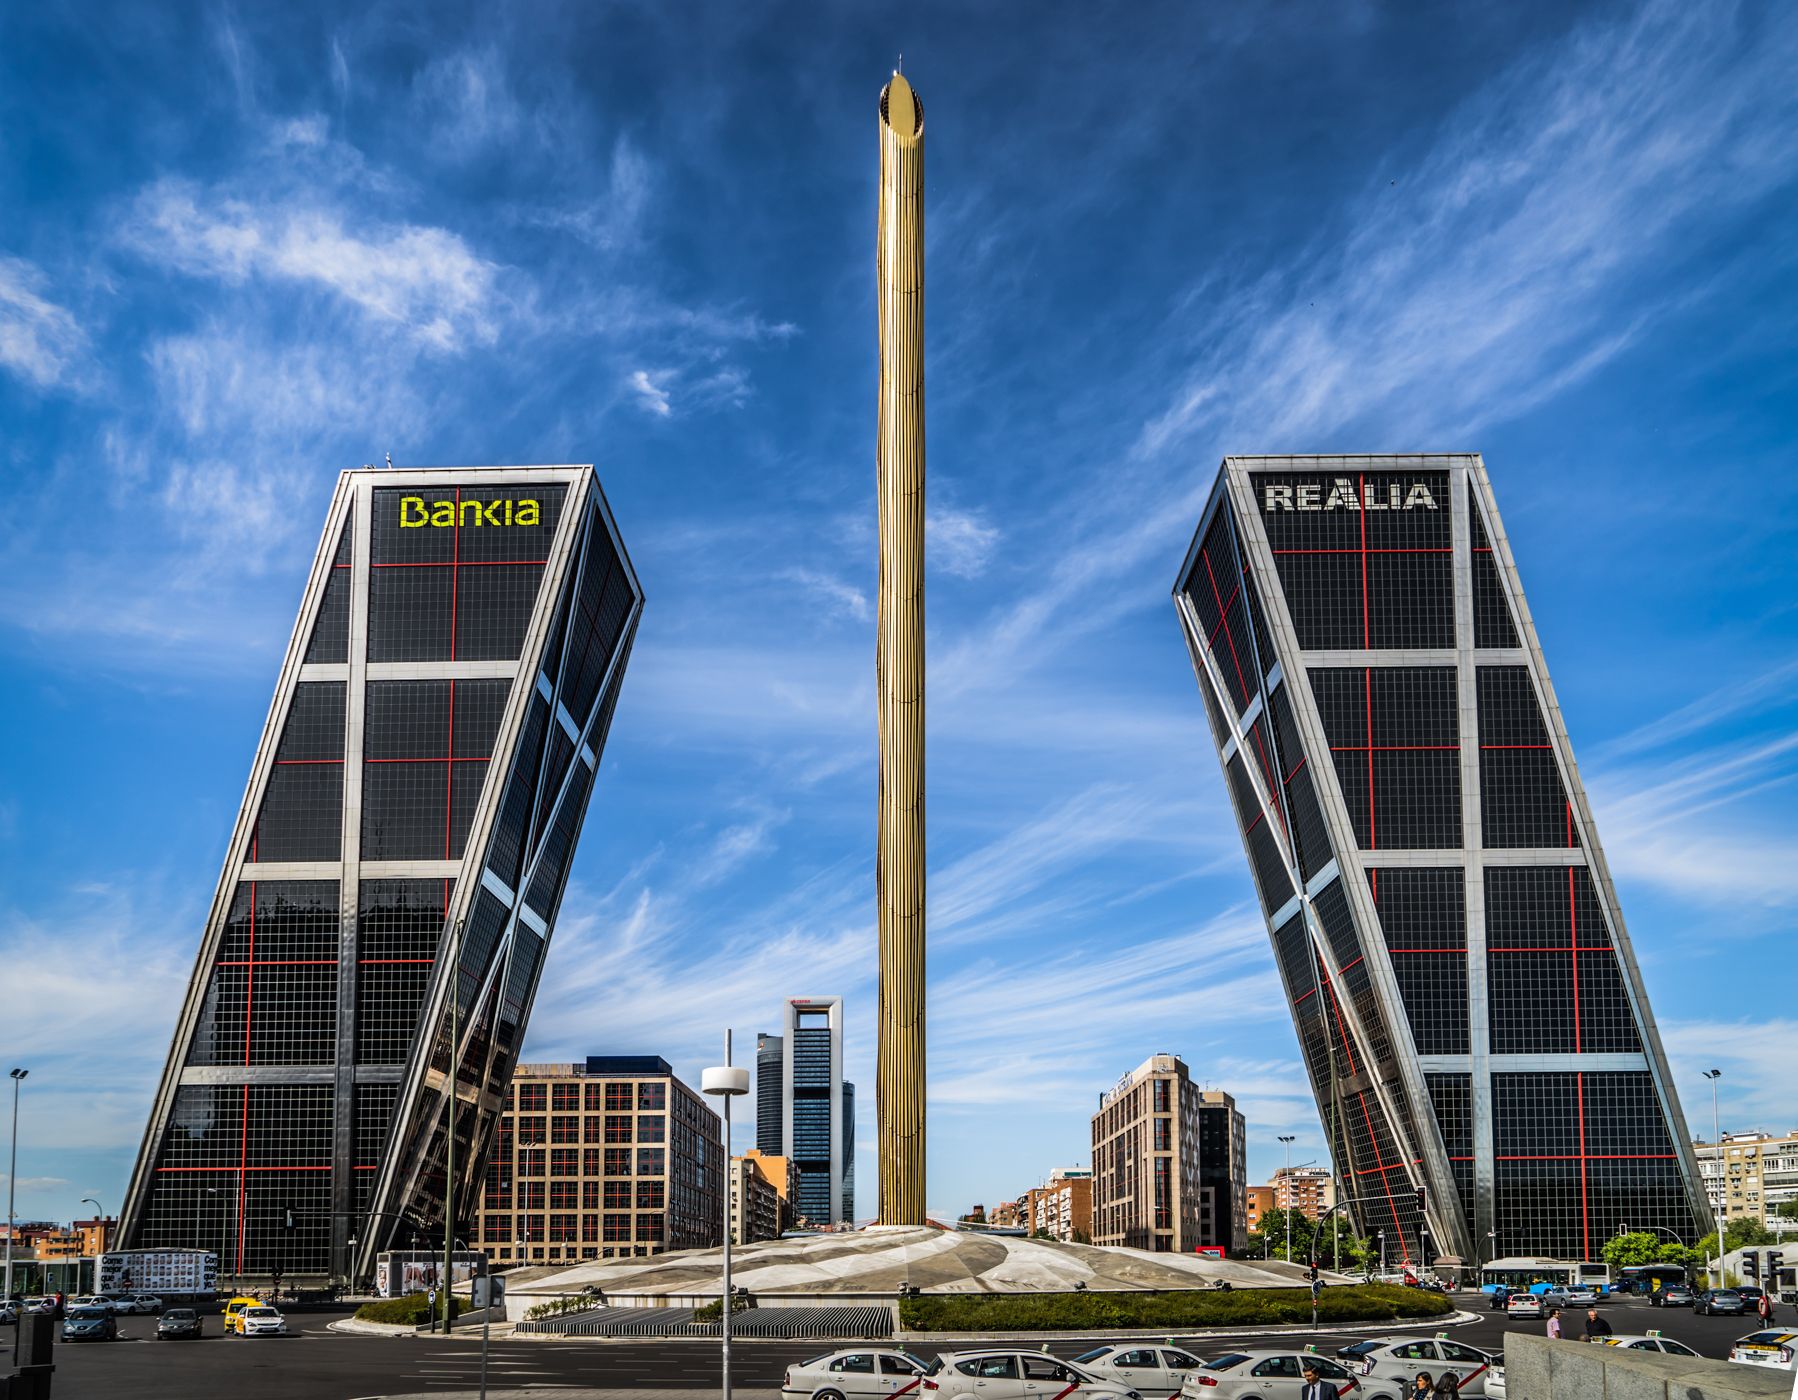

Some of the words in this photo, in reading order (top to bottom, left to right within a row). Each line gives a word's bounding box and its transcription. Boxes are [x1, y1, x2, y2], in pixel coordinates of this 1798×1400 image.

[1266, 478, 1438, 511] REALIA
[400, 496, 540, 528] Bankia
[101, 1255, 123, 1265] Come
[101, 1265, 122, 1274] mejor
[101, 1275, 115, 1283] que
